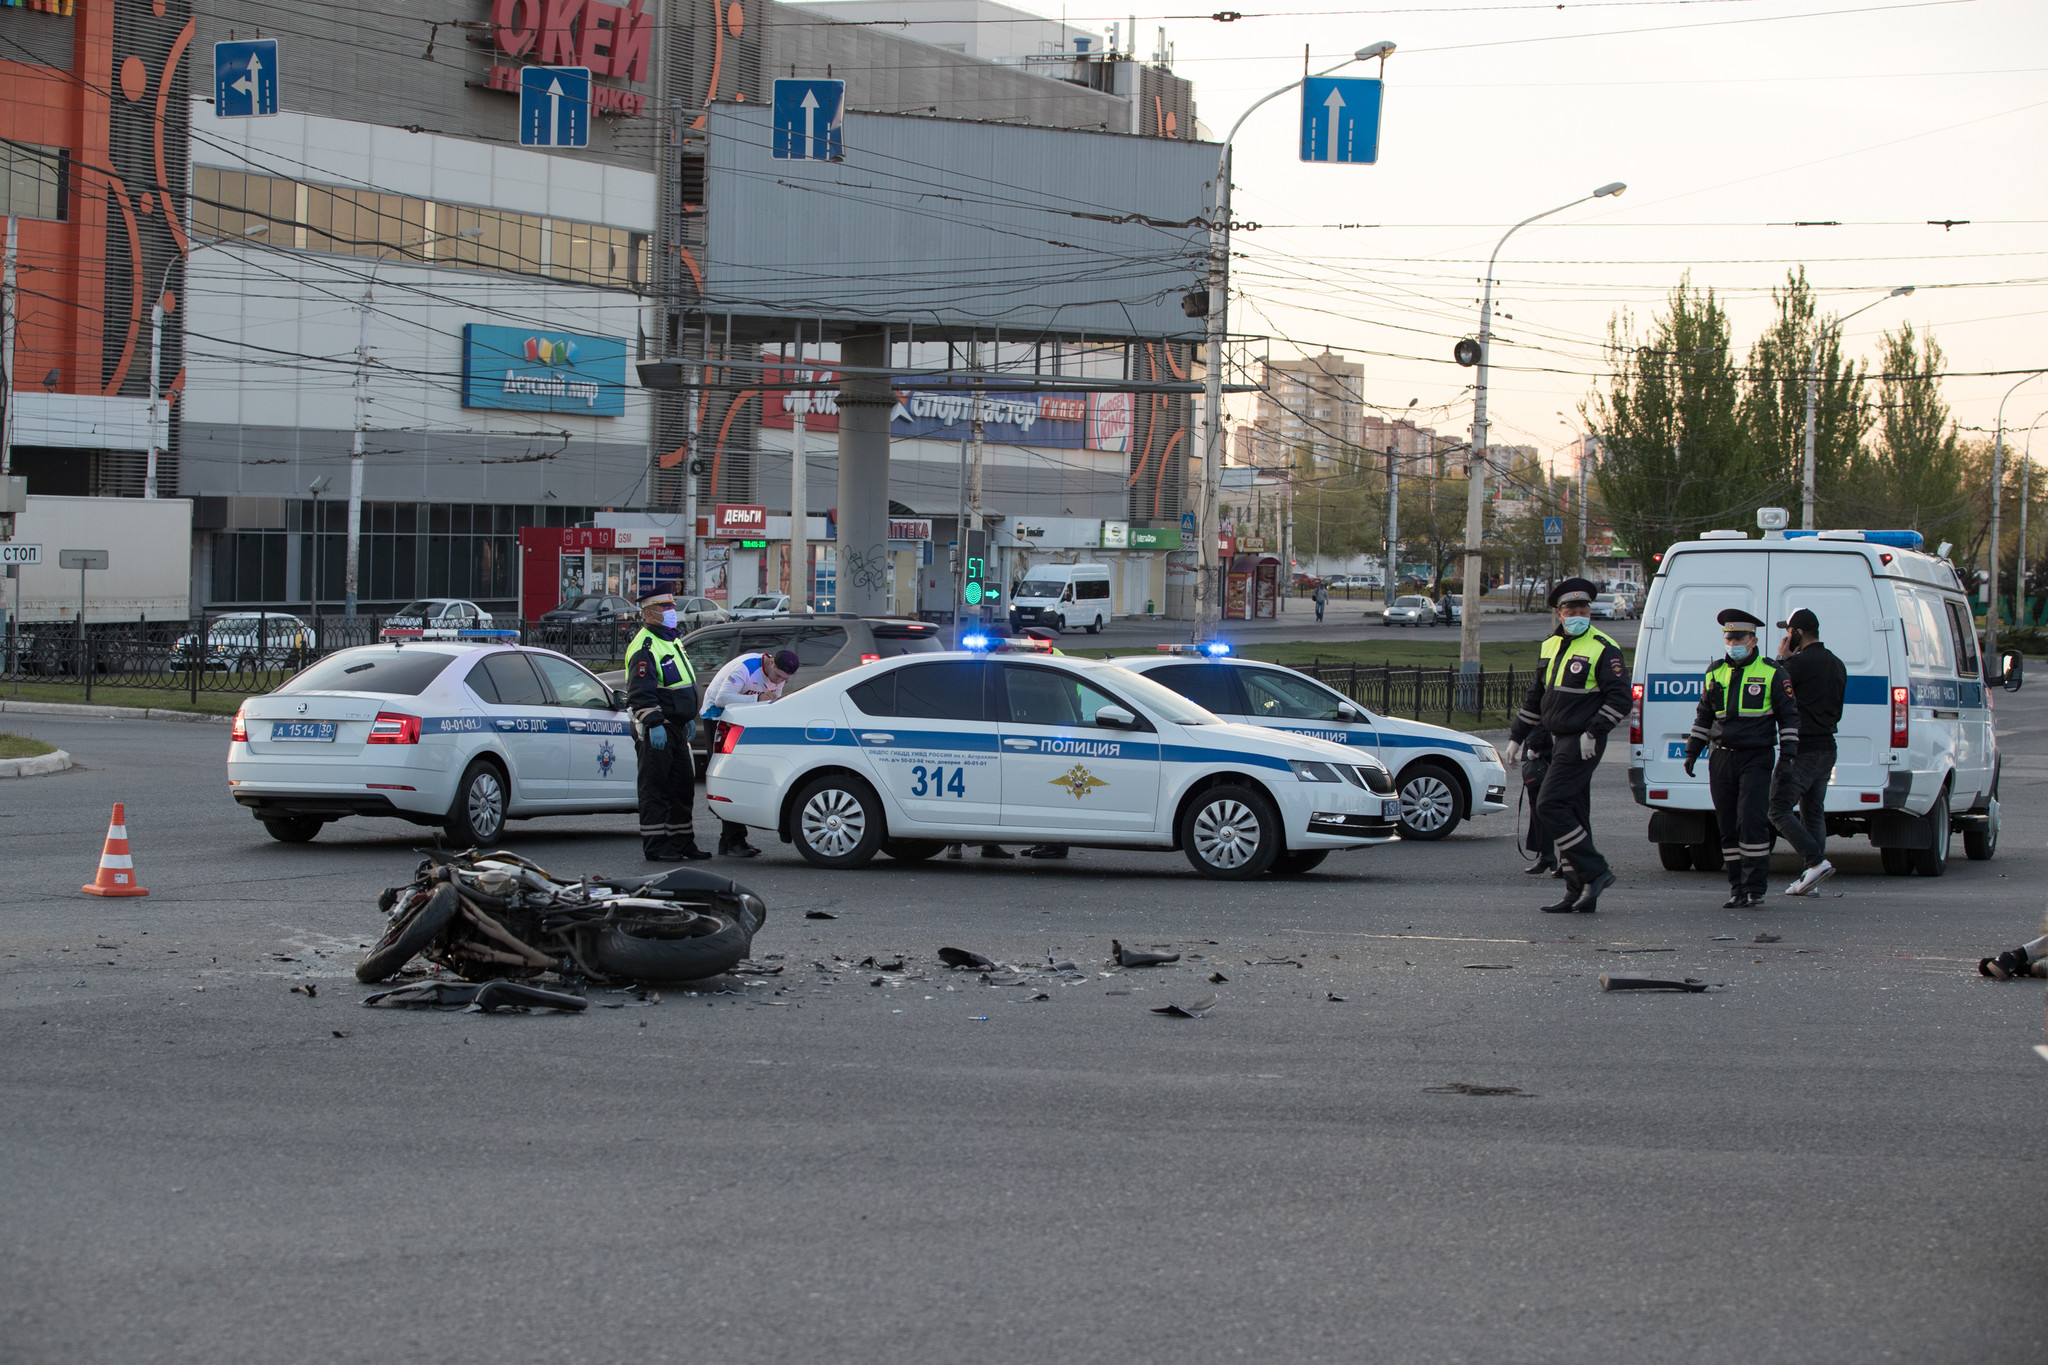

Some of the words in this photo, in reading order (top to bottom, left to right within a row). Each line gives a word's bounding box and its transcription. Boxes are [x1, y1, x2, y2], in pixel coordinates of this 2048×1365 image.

[503, 369, 565, 396] Детский
[567, 378, 598, 407] мир
[1042, 398, 1085, 419] ГИПЕР
[1100, 393, 1125, 420] BURGER
[1100, 409, 1126, 446] KING
[724, 509, 762, 525] ДЕНЬГИ
[618, 533, 631, 543] GSM
[3, 547, 37, 561] СТОП
[968, 557, 984, 578] 57
[277, 726, 284, 736] А
[289, 724, 314, 736] 1514
[320, 724, 332, 733] 30
[440, 718, 478, 731] 40-01-01
[516, 718, 529, 730] ОБ
[530, 719, 548, 733] ДПС
[586, 721, 623, 735] ПОЛИЦИЯ
[1040, 740, 1120, 757] ПОЛИЦИЯ
[911, 765, 965, 798] 314
